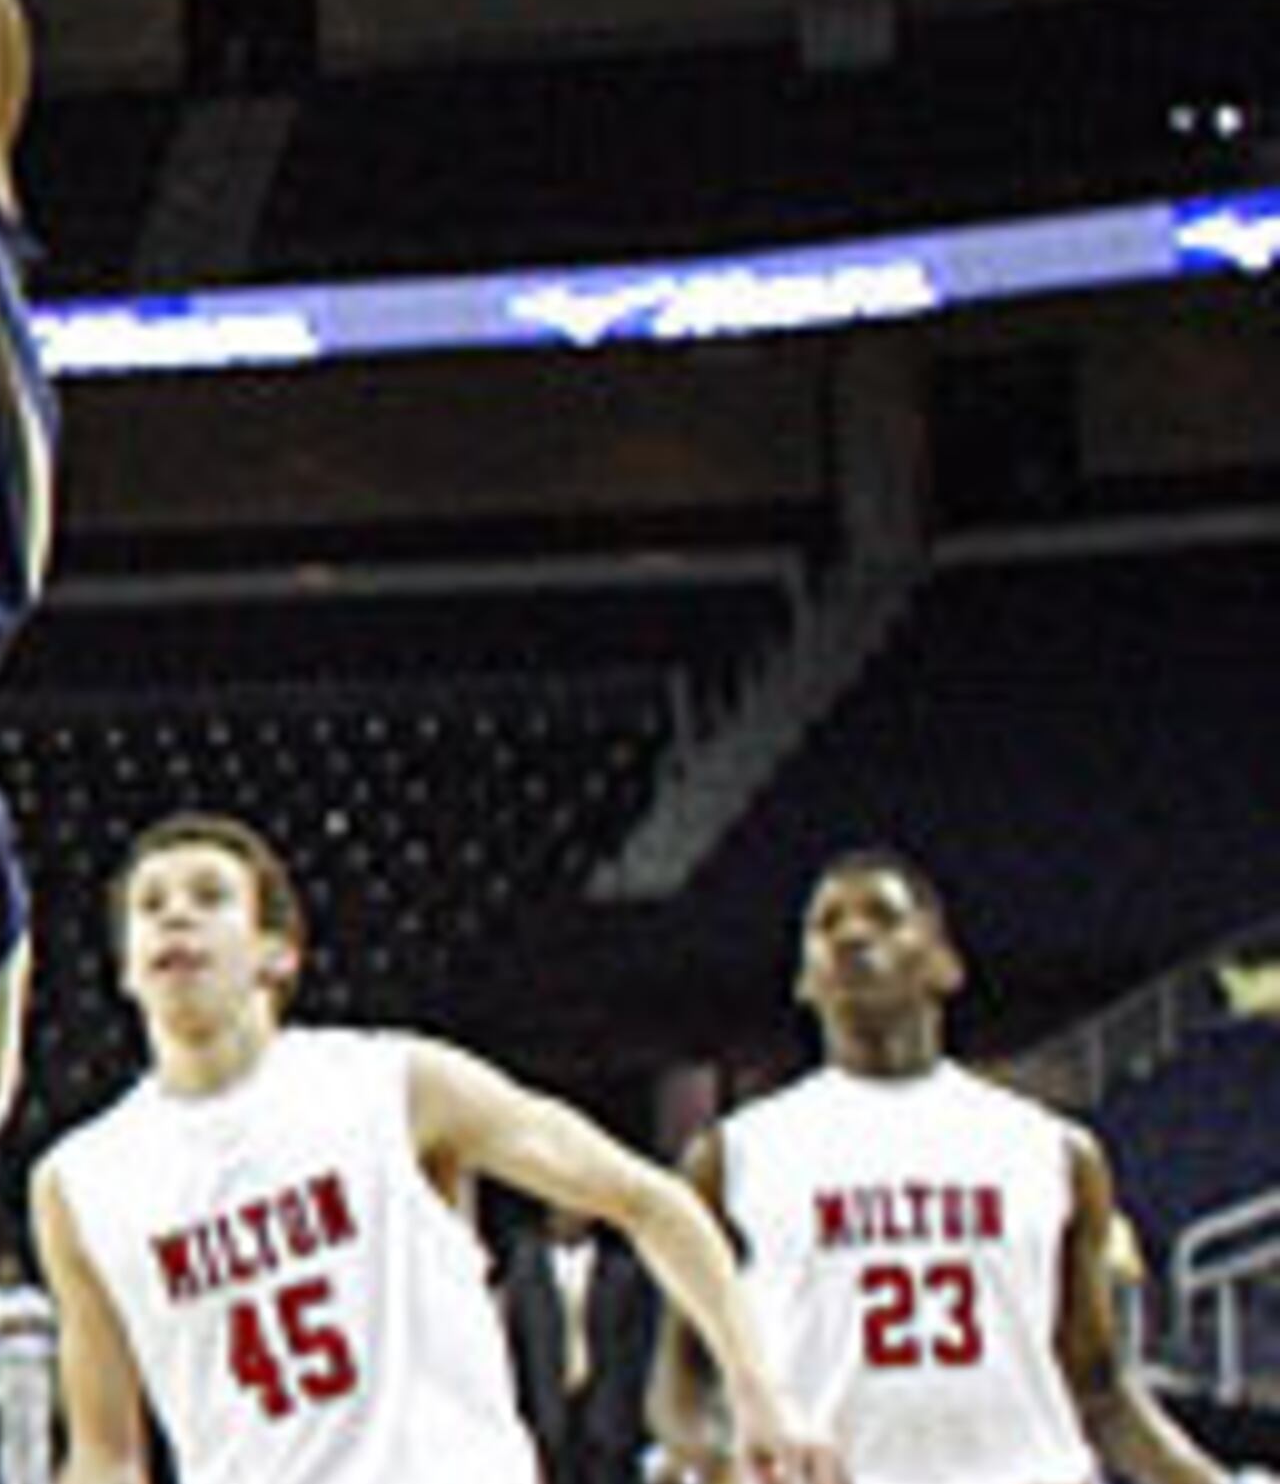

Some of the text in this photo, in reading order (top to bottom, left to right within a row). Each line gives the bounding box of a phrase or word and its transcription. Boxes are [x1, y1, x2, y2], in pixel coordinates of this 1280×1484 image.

[151, 1171, 356, 1303] MILTON
[814, 1183, 1004, 1251] MILTON
[228, 1277, 358, 1420] 45
[858, 1263, 984, 1369] 23
